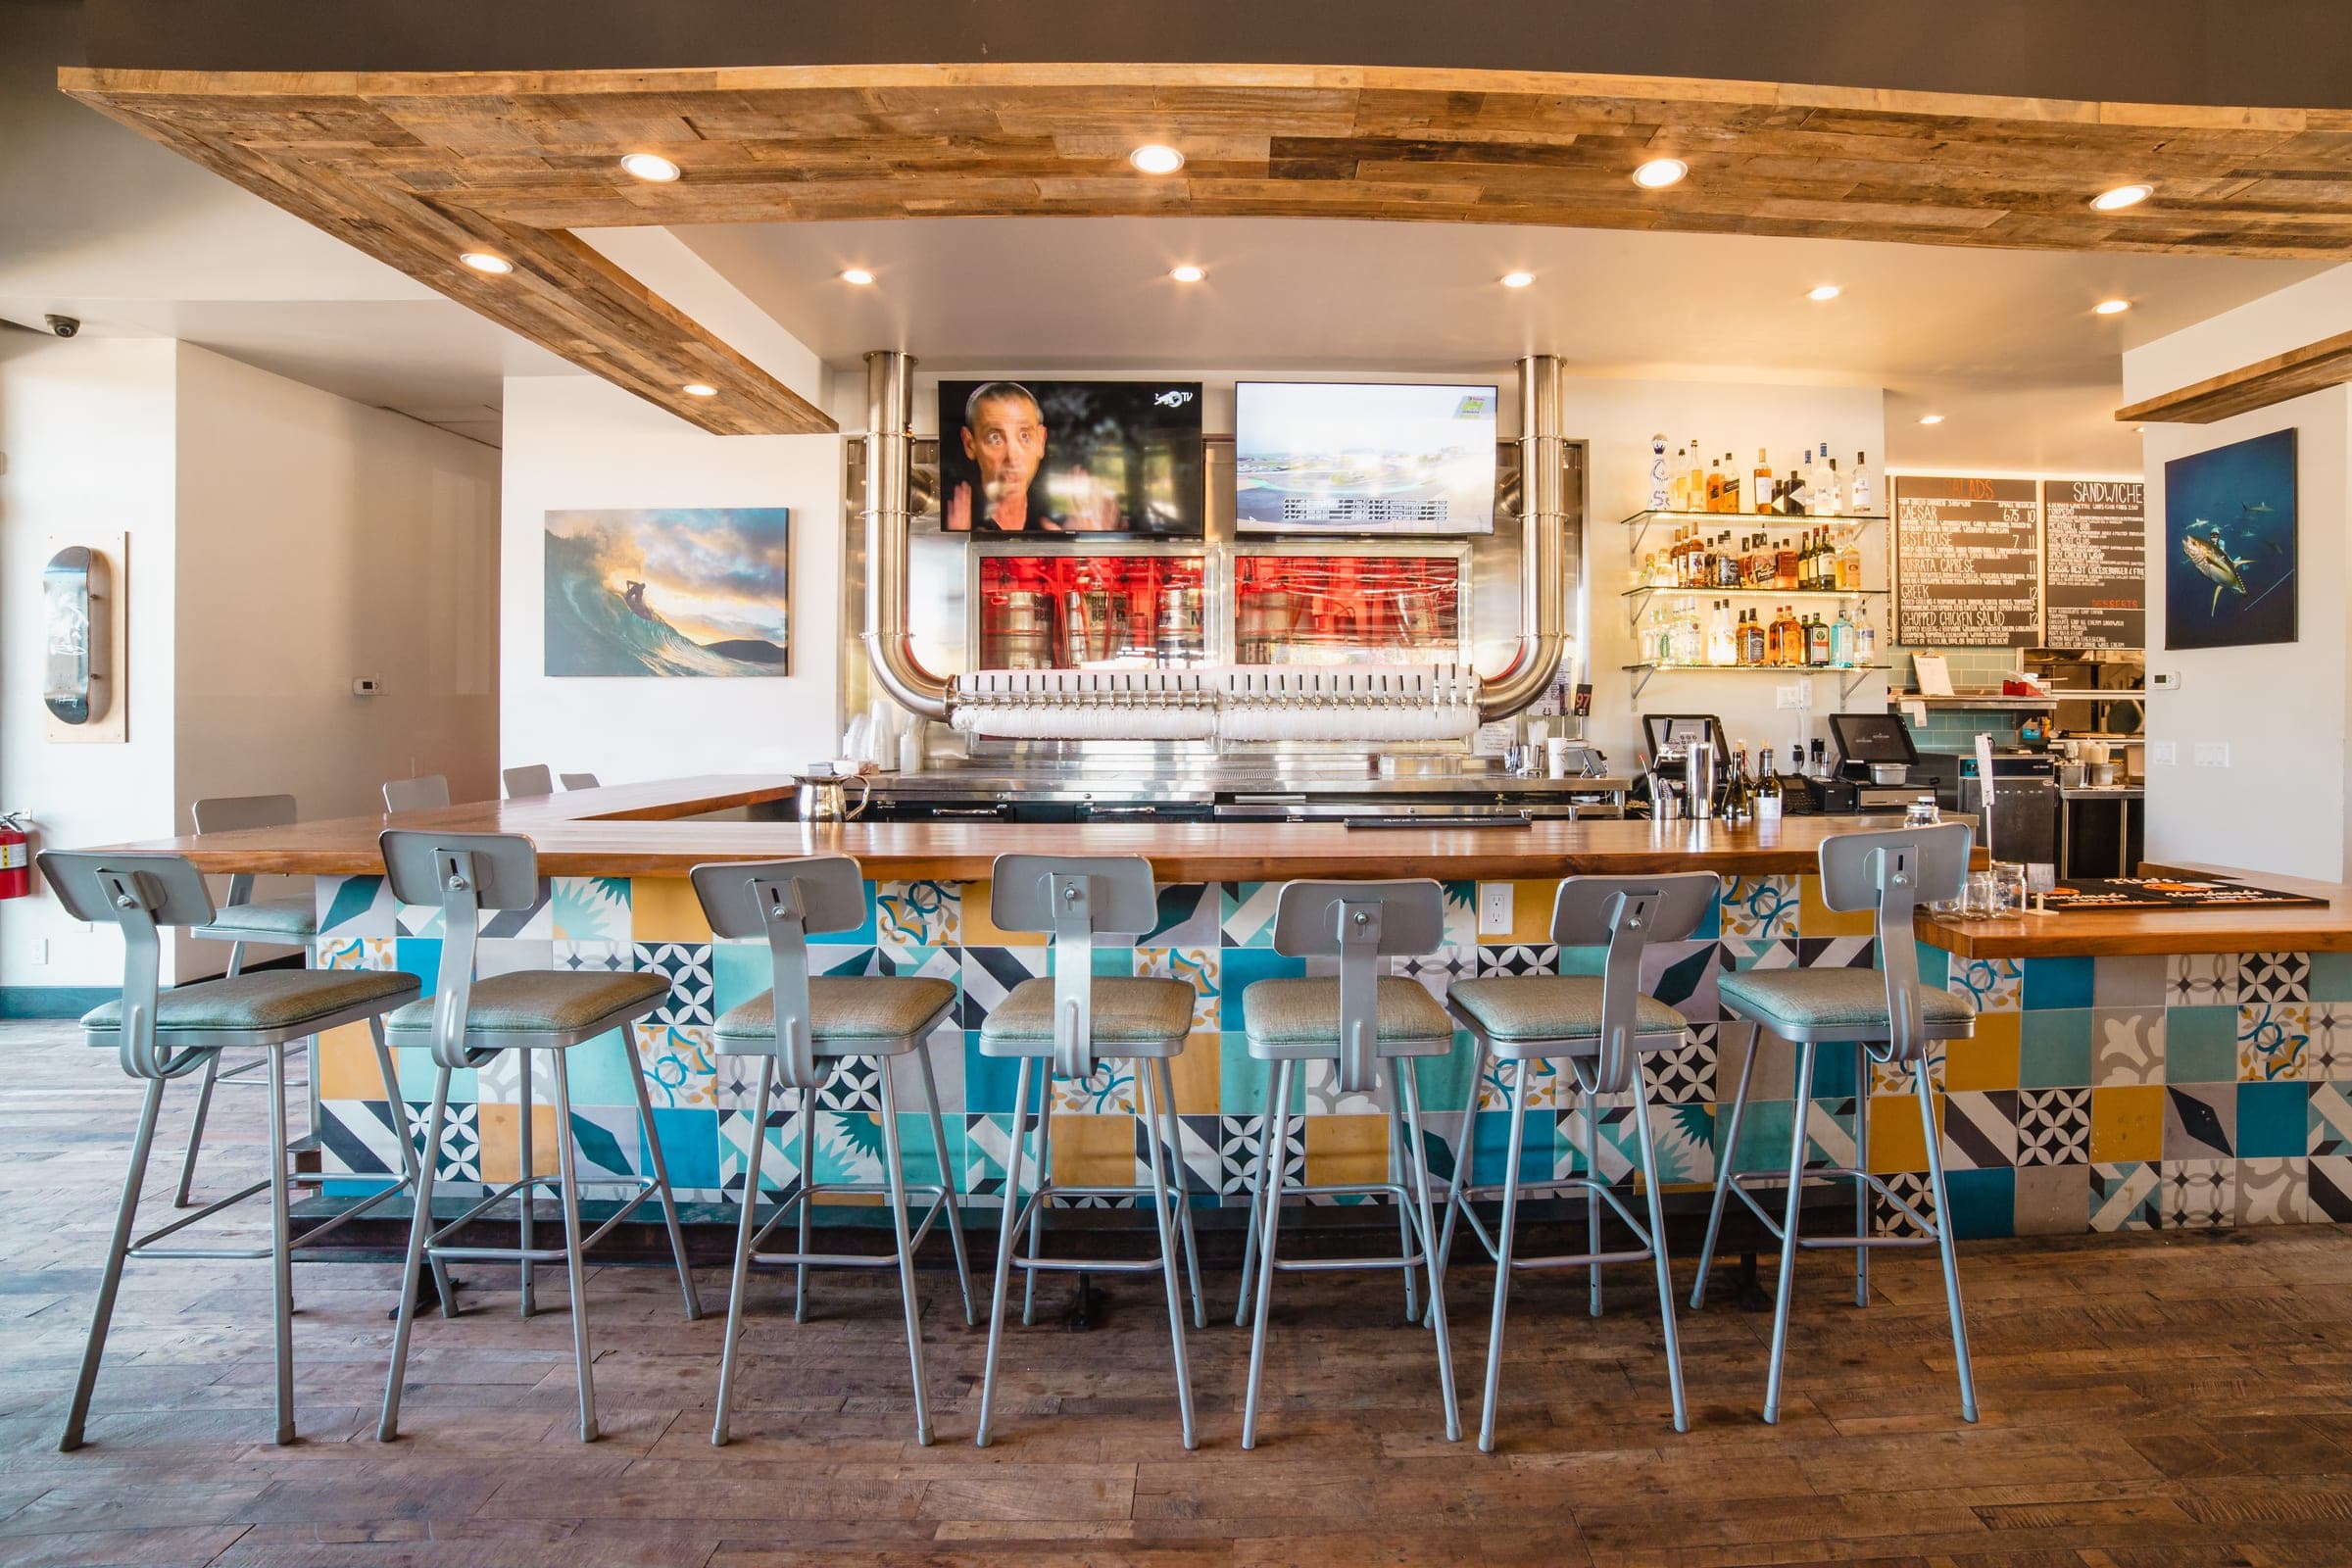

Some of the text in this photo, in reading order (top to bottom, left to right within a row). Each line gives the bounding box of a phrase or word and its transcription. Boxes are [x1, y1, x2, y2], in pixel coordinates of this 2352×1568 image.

[1181, 392, 1193, 401] TV
[1900, 506, 1937, 520] CAESAR
[2028, 510, 2036, 522] 10
[1900, 533, 1921, 546] BEST
[1923, 533, 1953, 547] HOUSE
[2012, 535, 2019, 548] 7
[1940, 559, 1975, 573] CAPRESE
[1901, 585, 2038, 599] GREEK 12
[1902, 612, 2039, 626] CHOPPED CHICKEN SALAD 12
[1576, 693, 1592, 708] 97
